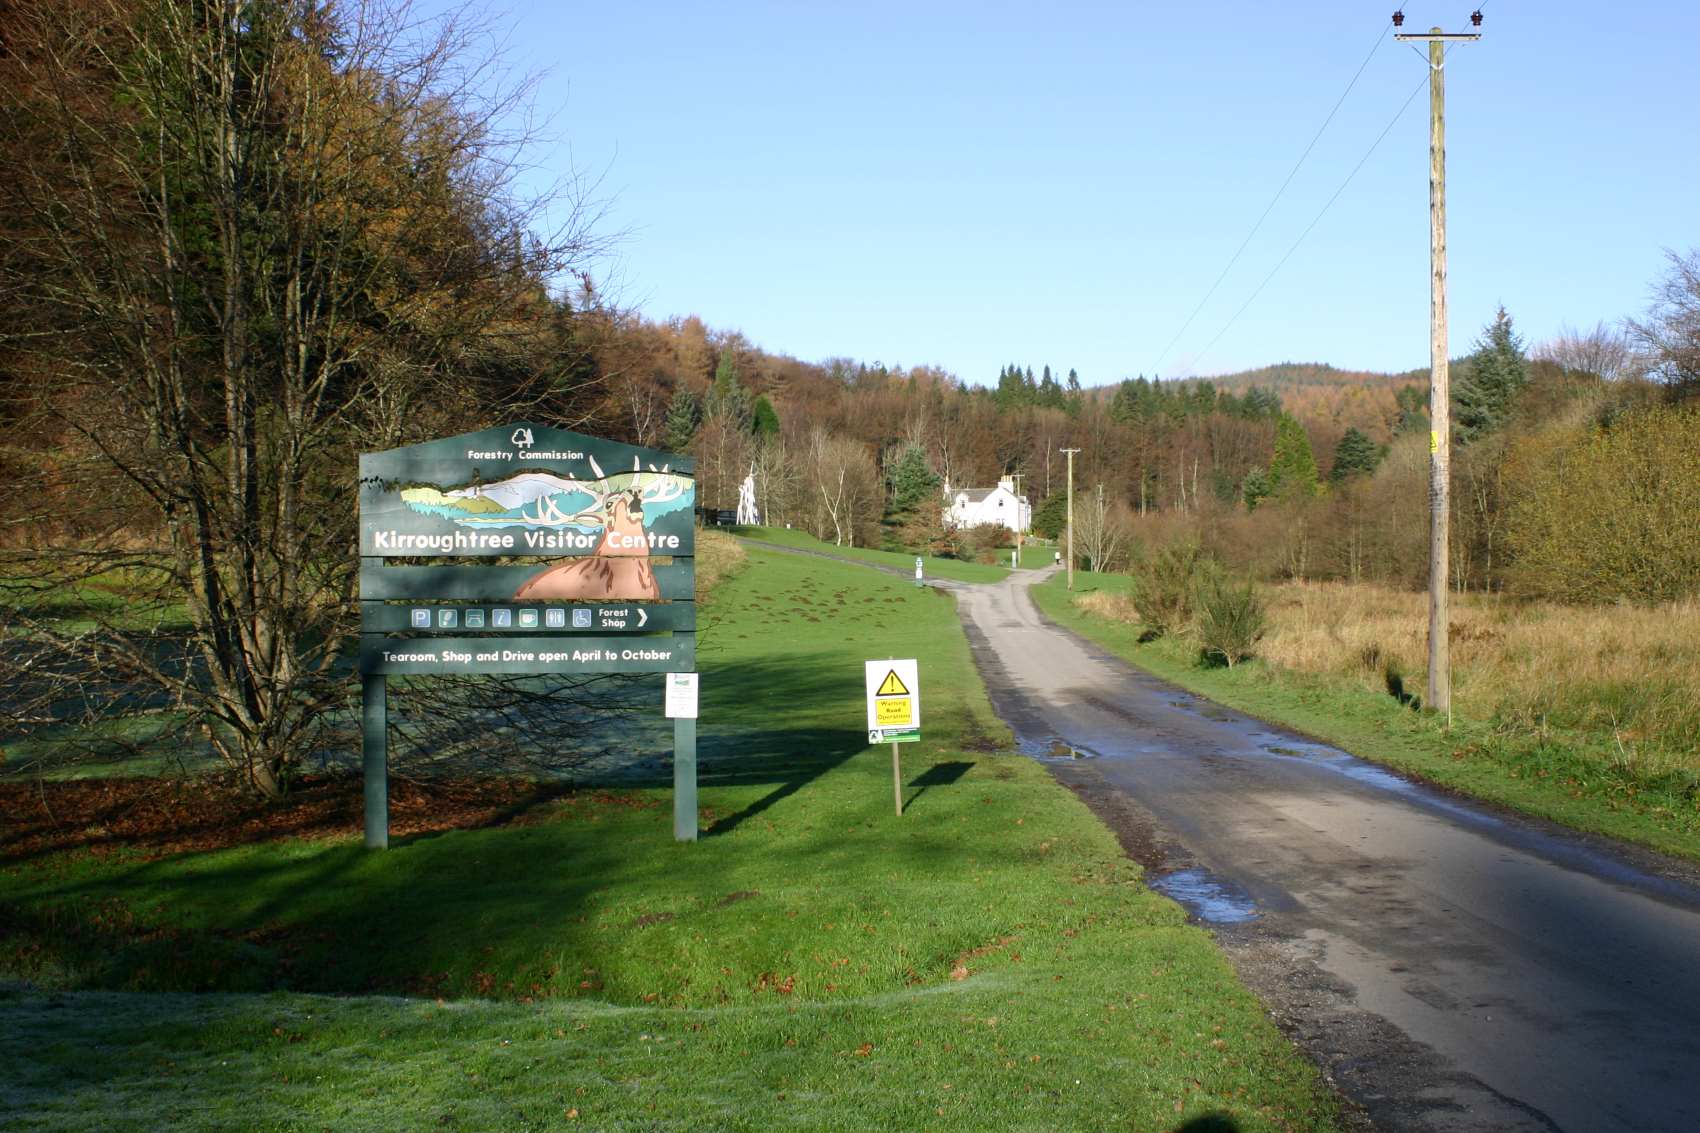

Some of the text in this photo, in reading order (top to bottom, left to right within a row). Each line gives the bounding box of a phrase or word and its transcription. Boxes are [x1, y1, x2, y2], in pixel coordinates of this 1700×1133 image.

[468, 450, 584, 461] Forestry Commission
[374, 531, 680, 552] Kirroughtree Visitor Centre
[599, 608, 628, 617] Forest
[602, 618, 626, 628] Shop
[383, 650, 672, 663] Tearoom, Shop and Drive open April to October
